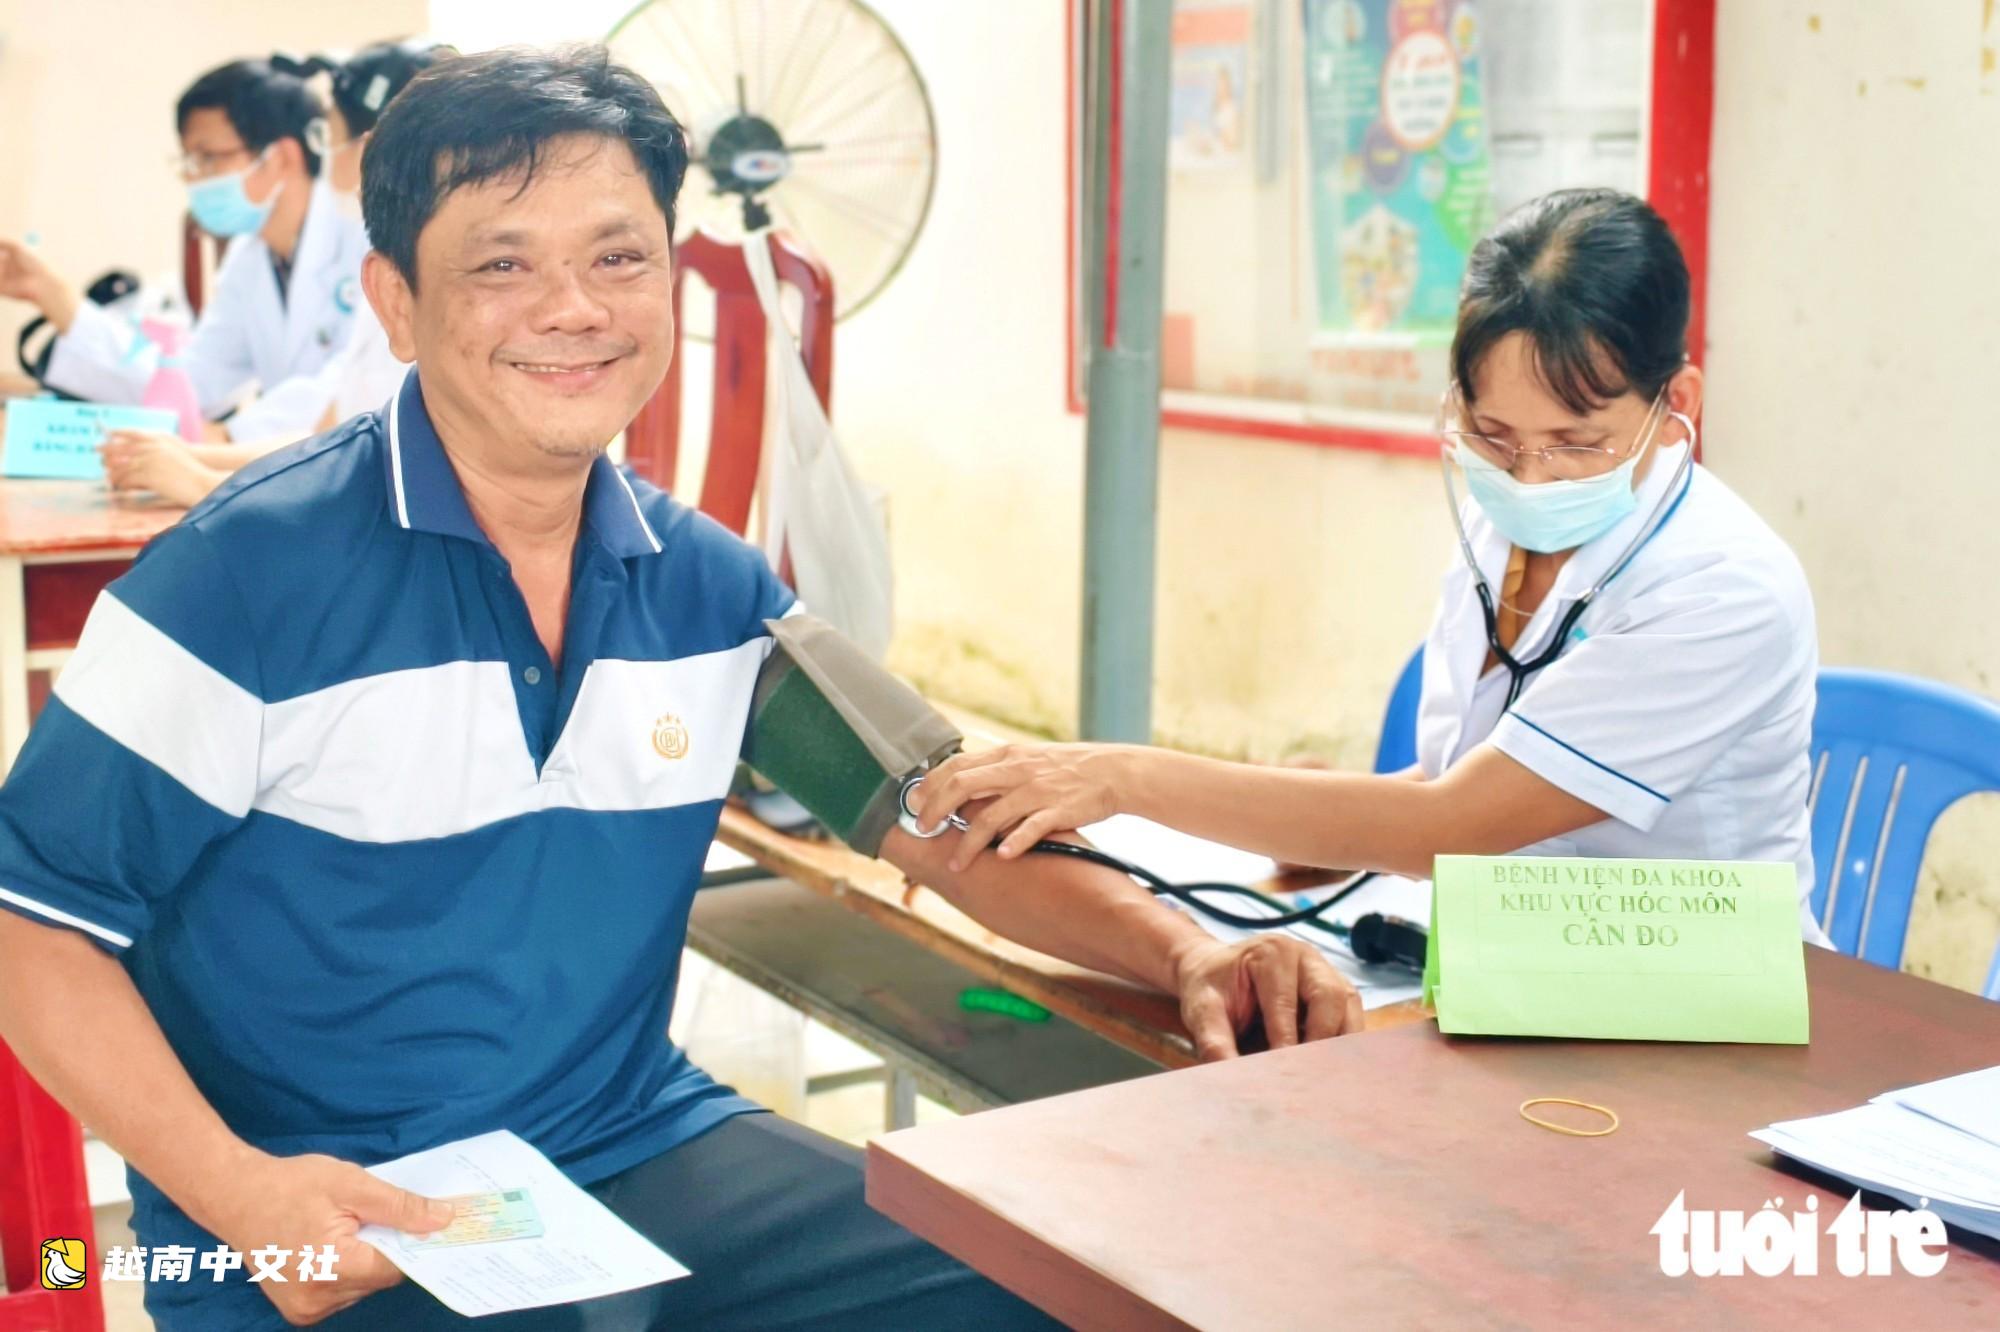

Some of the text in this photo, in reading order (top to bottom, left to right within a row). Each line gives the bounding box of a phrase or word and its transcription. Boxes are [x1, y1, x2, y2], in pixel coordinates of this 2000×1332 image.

[1565, 865, 1623, 889] VIỆN
[1671, 869, 1741, 888] KHOA
[1501, 890, 1736, 916] KHU VỰC HÓC MÔN
[1563, 918, 1624, 946] CÂN
